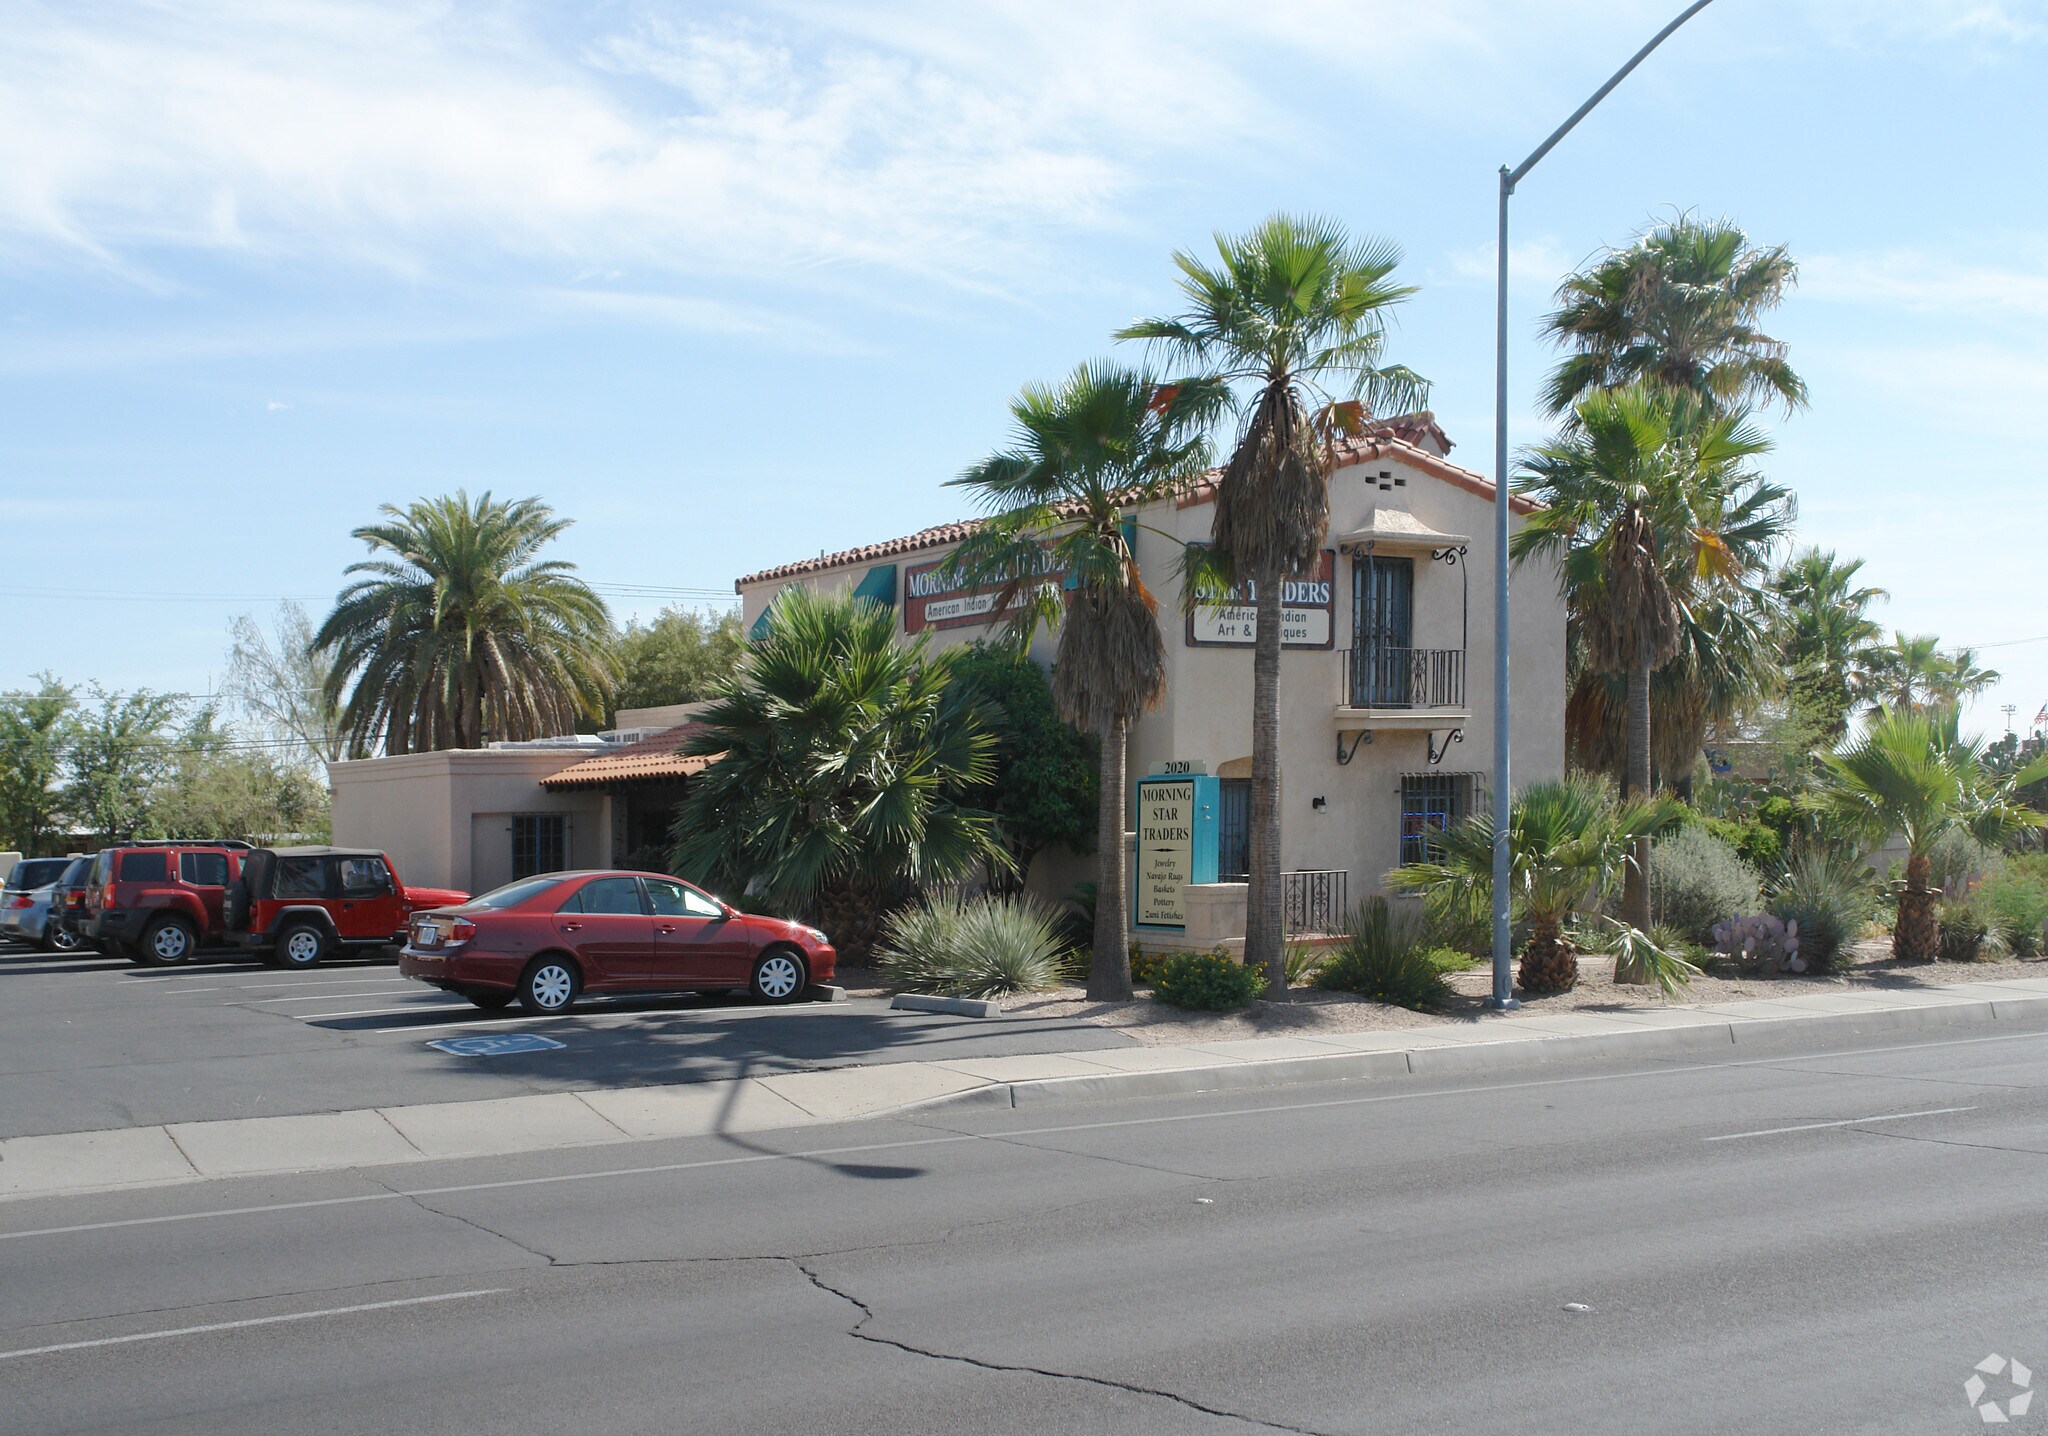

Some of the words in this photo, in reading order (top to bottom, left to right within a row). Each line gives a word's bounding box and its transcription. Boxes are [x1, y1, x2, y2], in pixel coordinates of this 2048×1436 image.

[909, 563, 971, 598] MORNIN
[1247, 579, 1330, 604] TDERS
[928, 602, 960, 618] American
[1218, 608, 1258, 621] Americ
[1281, 609, 1307, 622] dian
[1217, 623, 1236, 636] Art
[1243, 623, 1253, 637] &
[1280, 625, 1308, 641] iques
[1164, 761, 1190, 774] 2020
[1142, 787, 1191, 802] MORNING
[1152, 807, 1178, 821] STAR
[1143, 827, 1189, 841] TRADERS
[1153, 858, 1177, 870] Jewelry
[1146, 872, 1167, 883] Navajo
[1168, 872, 1184, 884] Rugs
[1153, 884, 1175, 893] Baskets
[1153, 898, 1175, 910] Pottery
[1160, 910, 1184, 920] Fetishes
